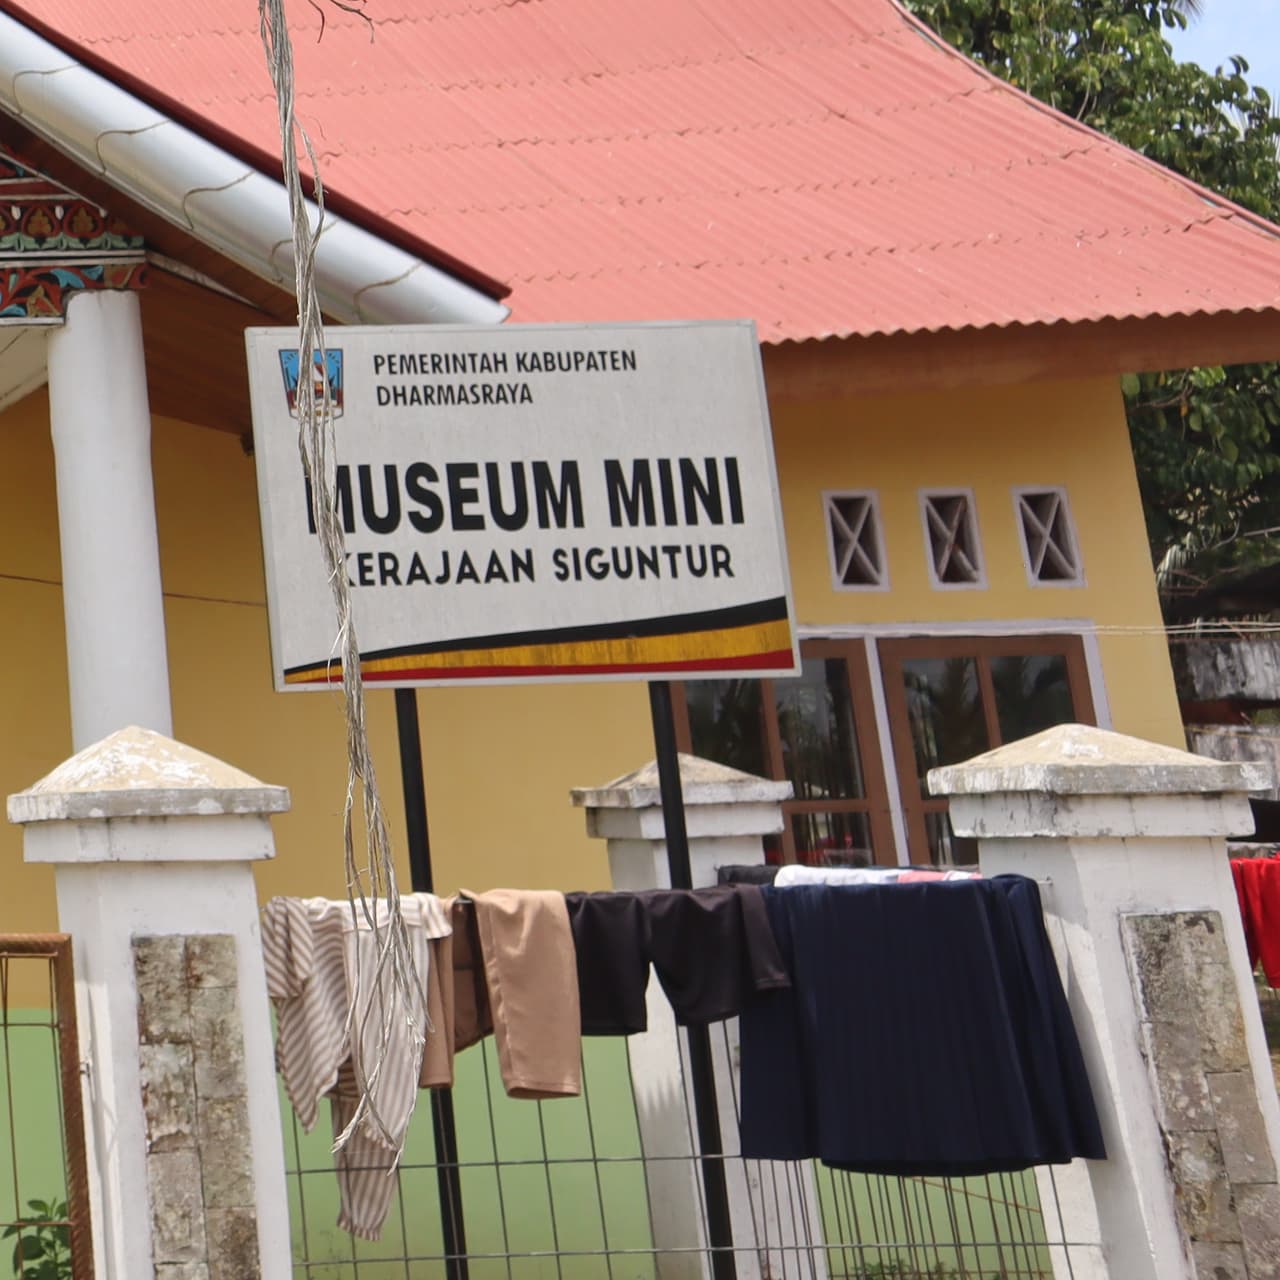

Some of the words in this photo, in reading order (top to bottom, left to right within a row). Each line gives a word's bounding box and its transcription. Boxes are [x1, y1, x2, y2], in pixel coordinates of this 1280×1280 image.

[373, 352, 508, 376] PEMERINTAH
[516, 349, 637, 373] KABUPATEN
[376, 382, 533, 407] DHARMASRAYA
[304, 459, 585, 535] MUSEUM
[604, 456, 745, 527] MINI
[552, 543, 735, 582] SIGUNTUR
